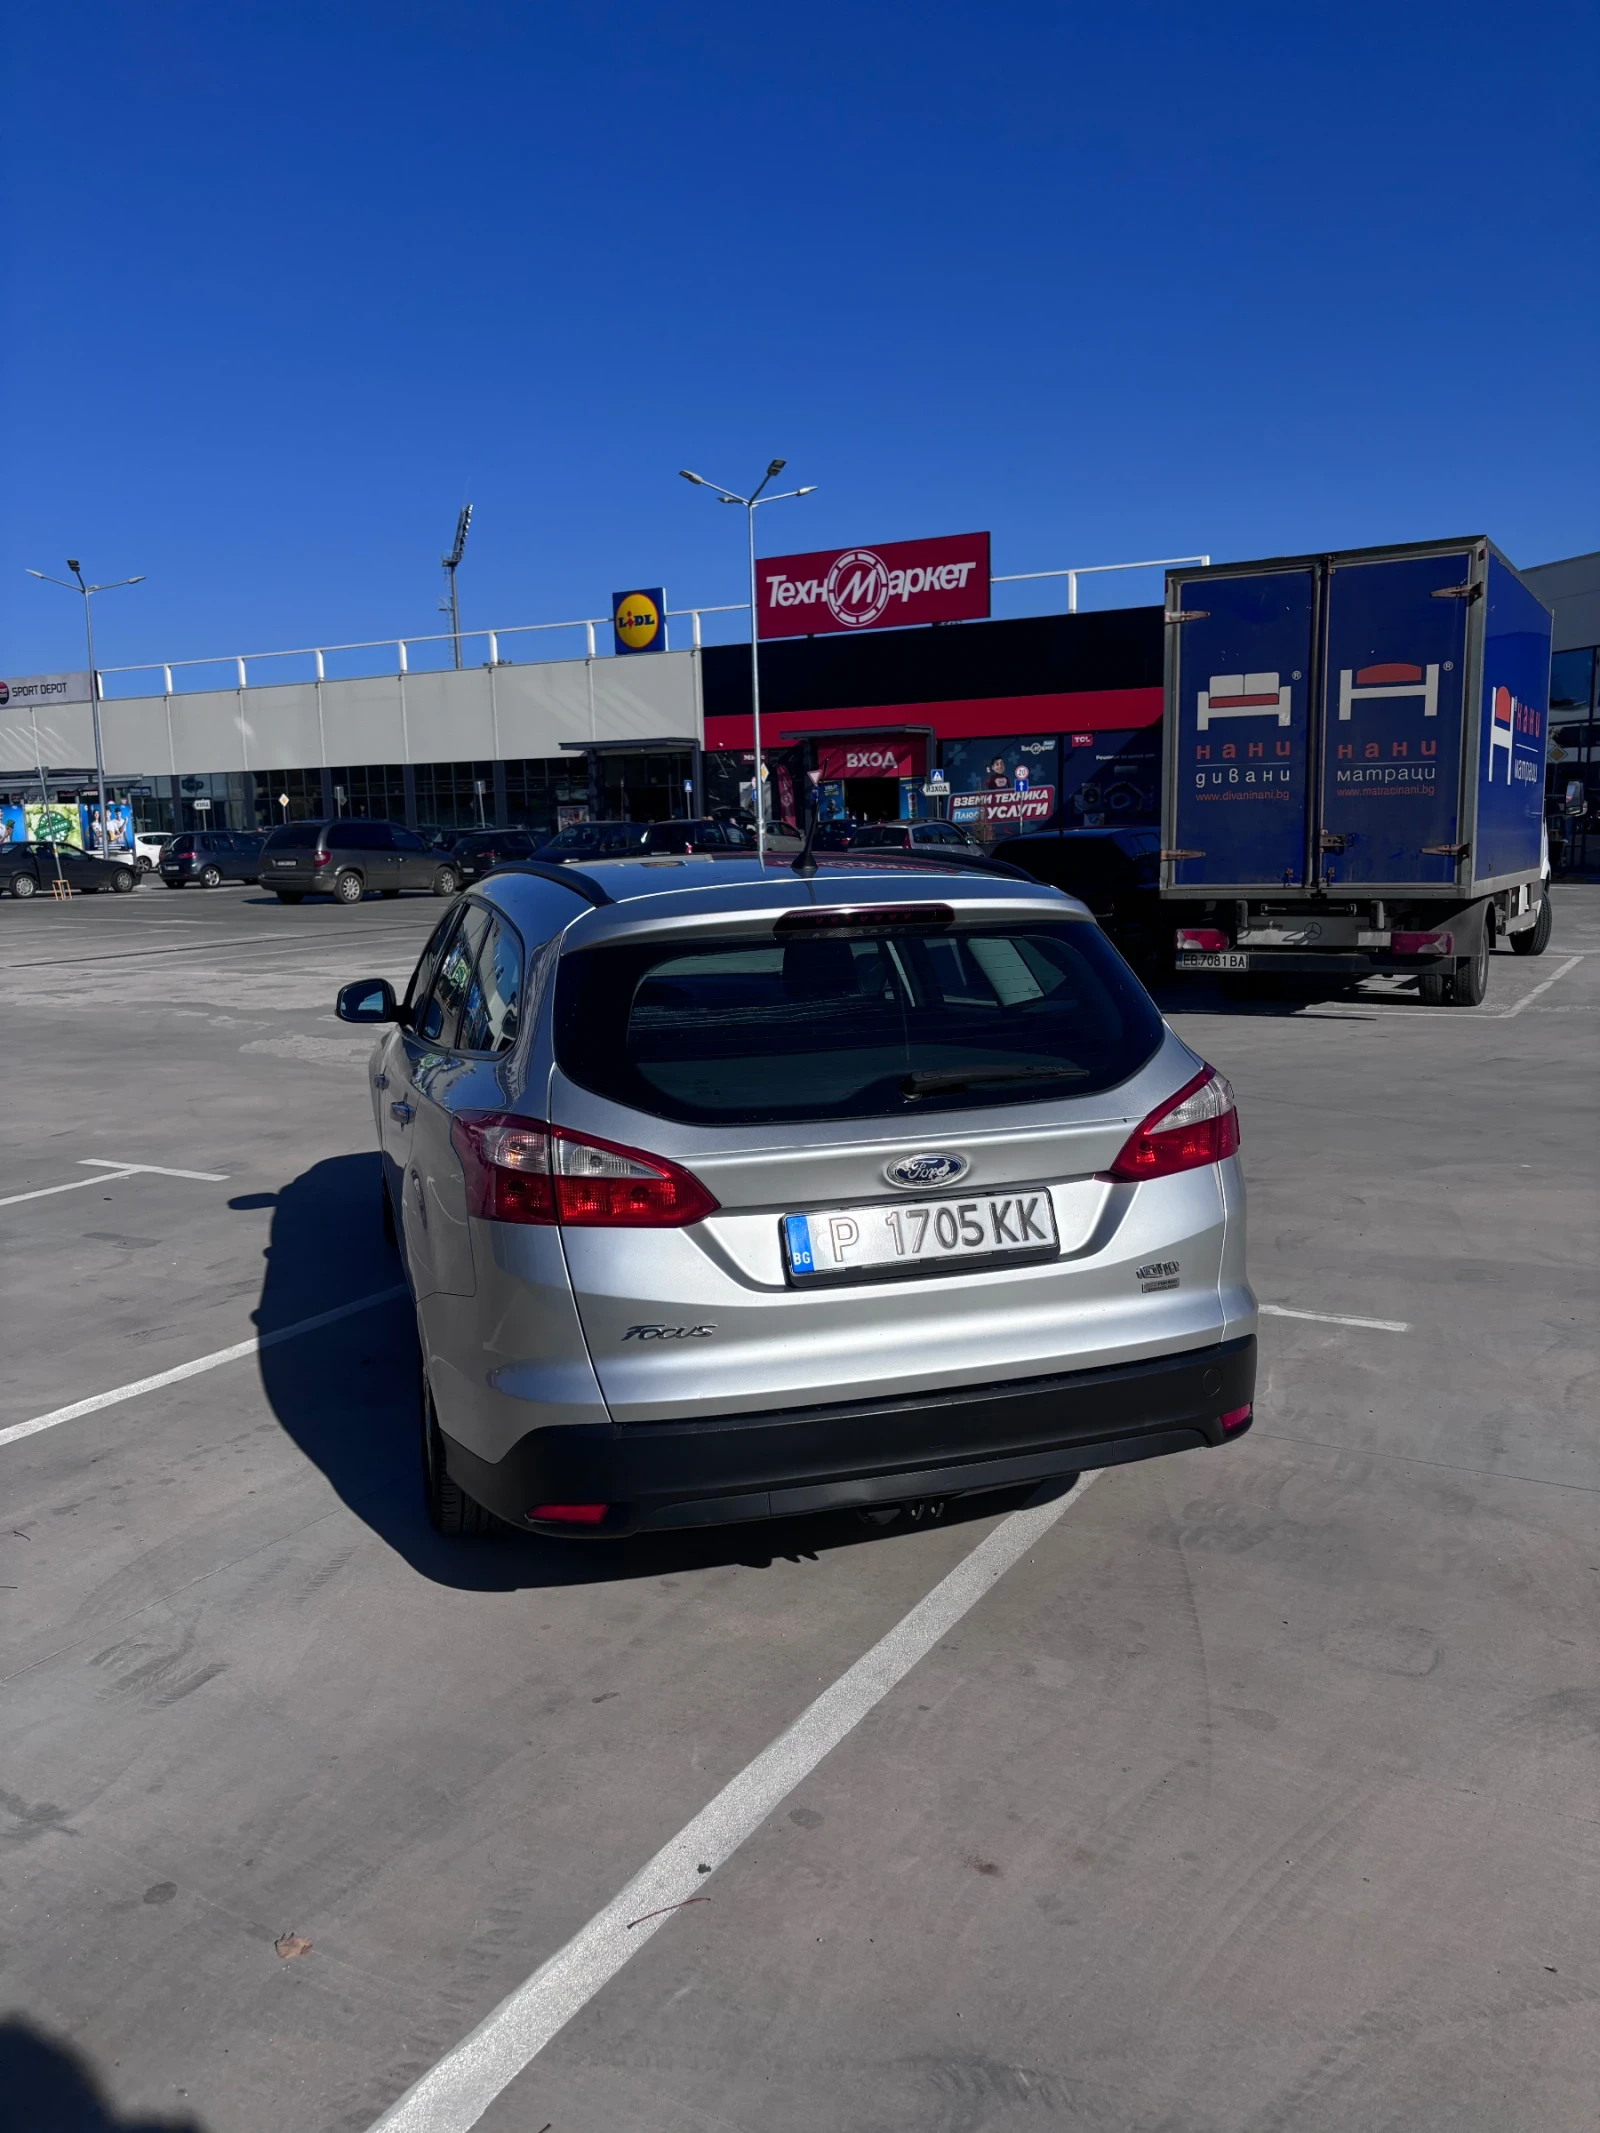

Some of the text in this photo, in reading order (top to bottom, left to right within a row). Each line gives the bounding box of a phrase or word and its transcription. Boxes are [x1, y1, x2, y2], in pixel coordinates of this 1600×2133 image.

[12, 685, 38, 697] SPORT
[41, 682, 67, 695] DEPOT
[1196, 741, 1291, 760] нани
[1337, 740, 1437, 759] нани
[846, 751, 898, 769] ВХОД
[1195, 768, 1290, 788] дивани
[1337, 767, 1436, 784] матраци
[926, 785, 948, 793] ИЗХОД
[1196, 790, 1290, 801] www.divaninani.bg
[1337, 785, 1435, 796] www.matracinani.bg
[953, 790, 1048, 807] ВЗЕМИ ТЕХНИКА
[987, 802, 1048, 820] УСЛУГИ
[907, 1159, 951, 1179] Ford
[792, 1252, 811, 1265] BG
